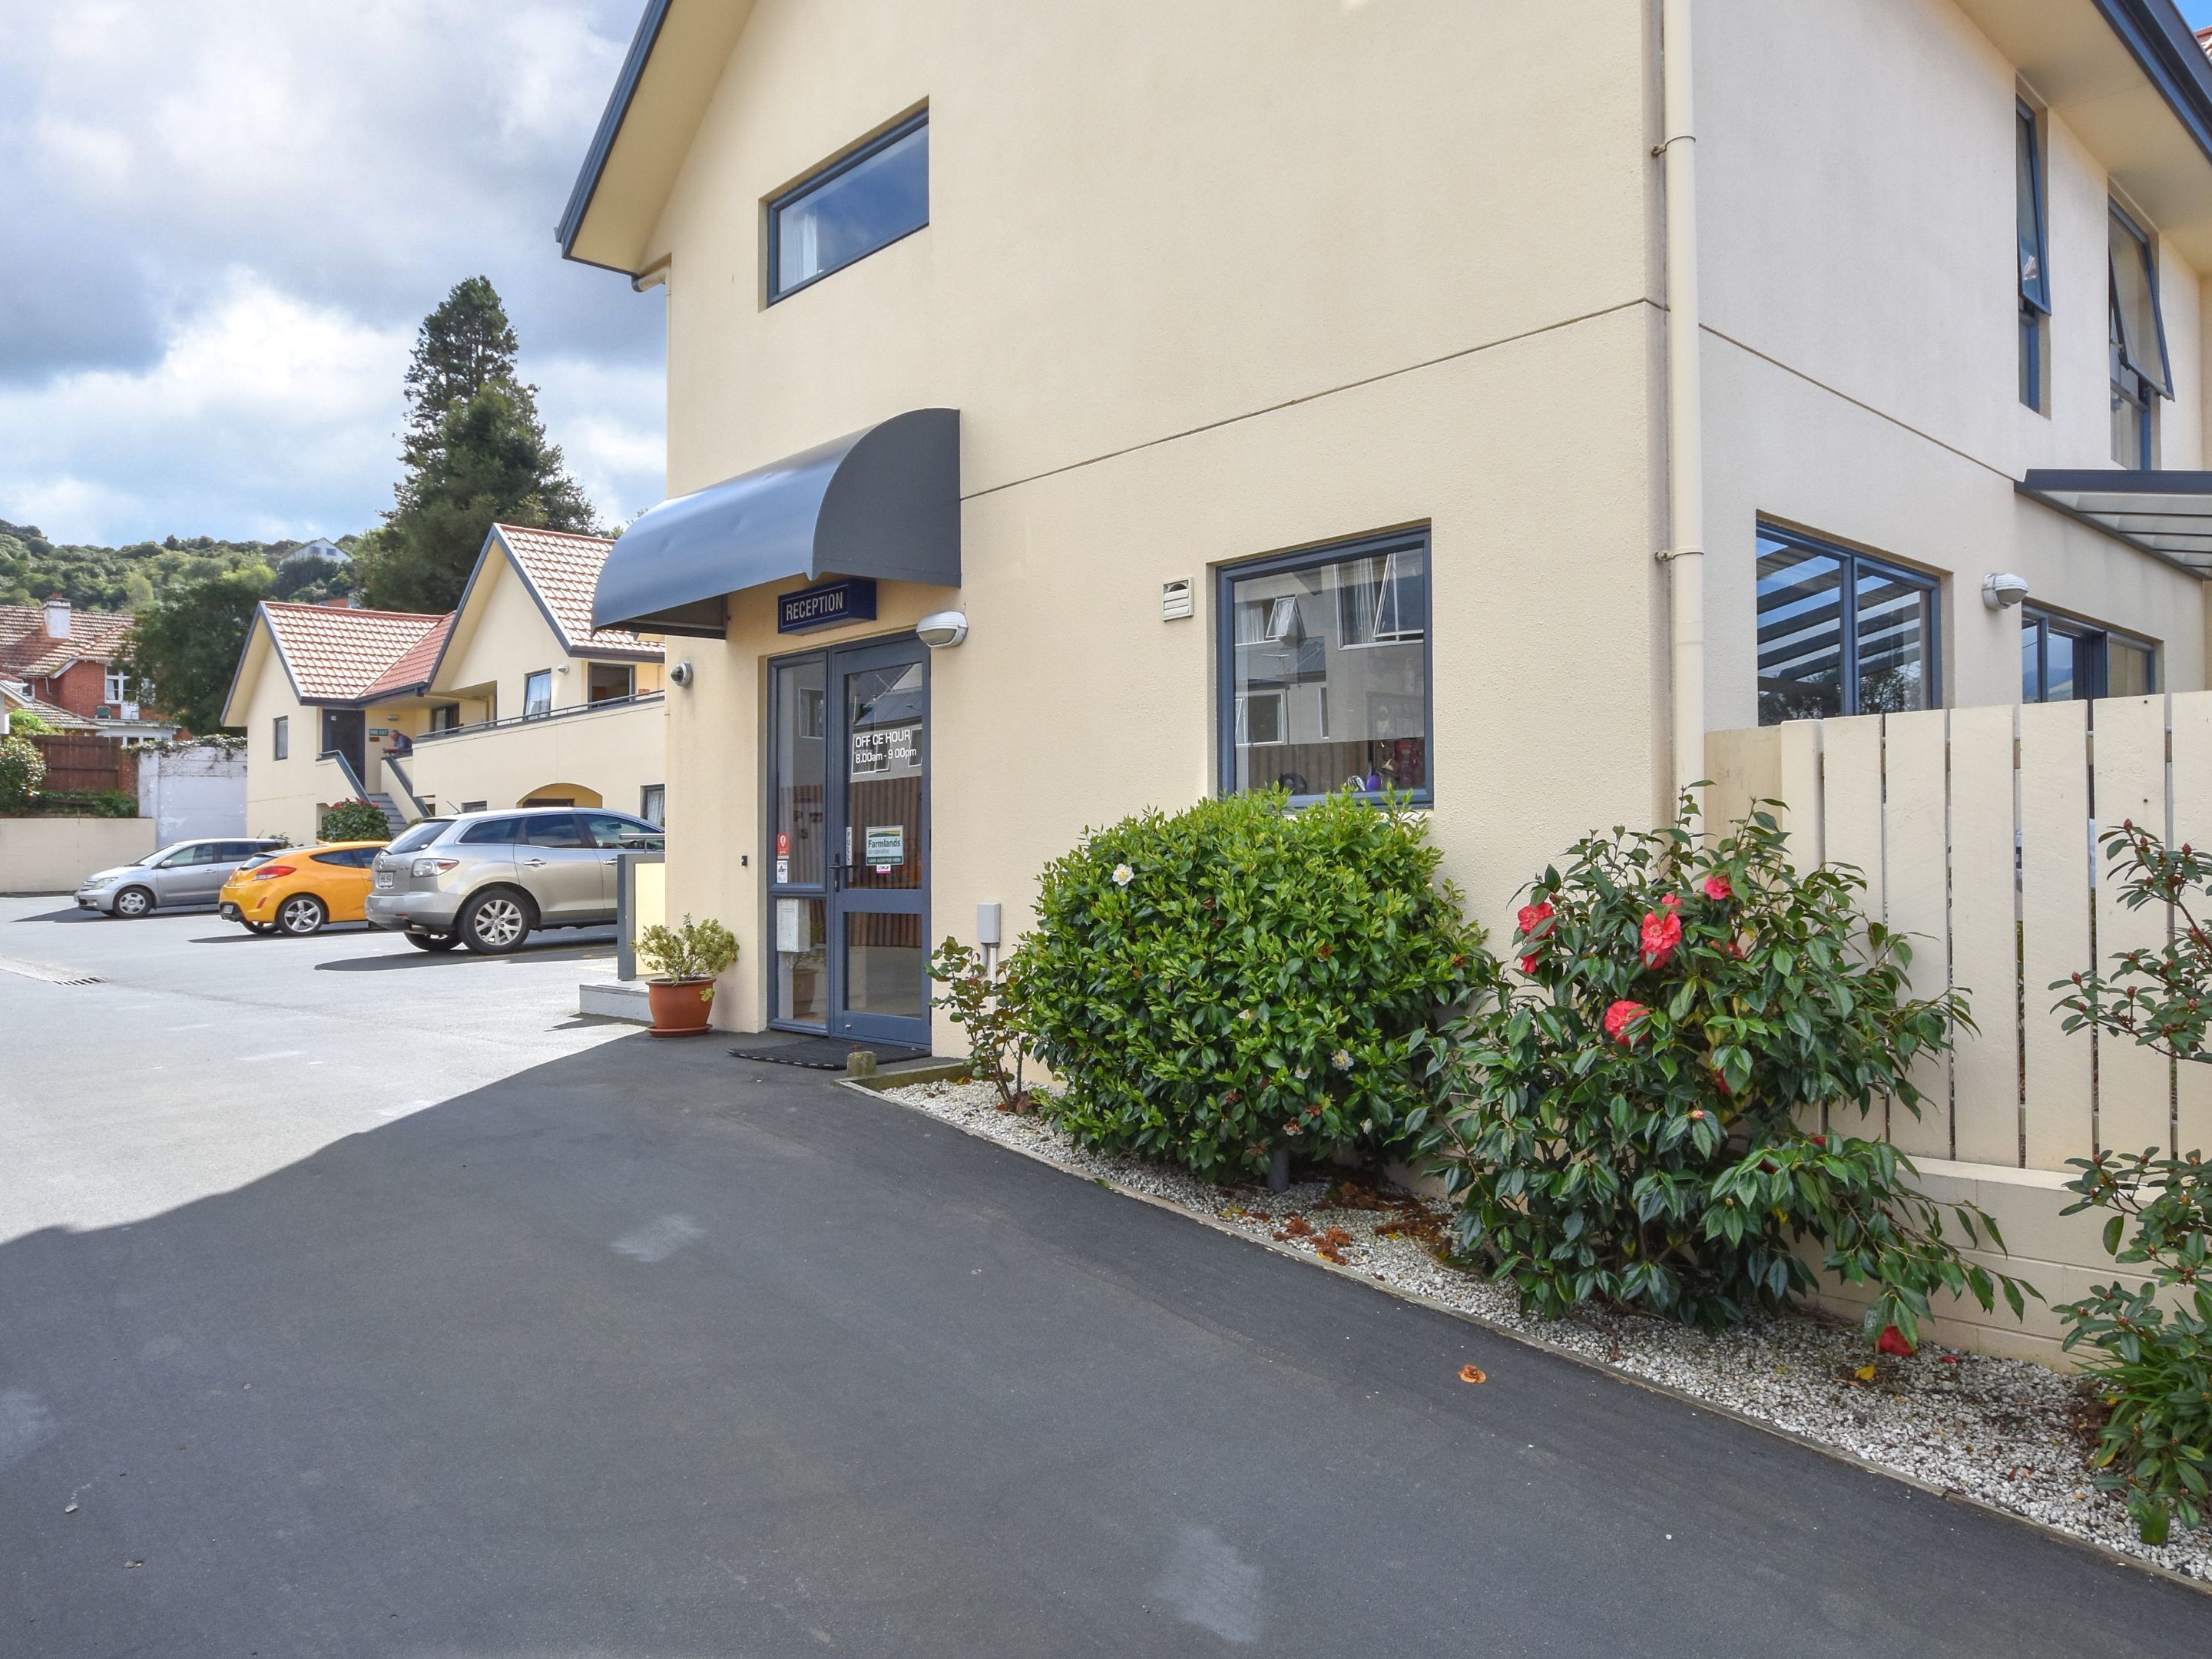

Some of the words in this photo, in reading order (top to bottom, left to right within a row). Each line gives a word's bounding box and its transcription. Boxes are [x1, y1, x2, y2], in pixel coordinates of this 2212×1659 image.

[786, 591, 843, 621] RECEPTION
[855, 752, 883, 764] 8.00am
[868, 838, 901, 849] Farmlands
